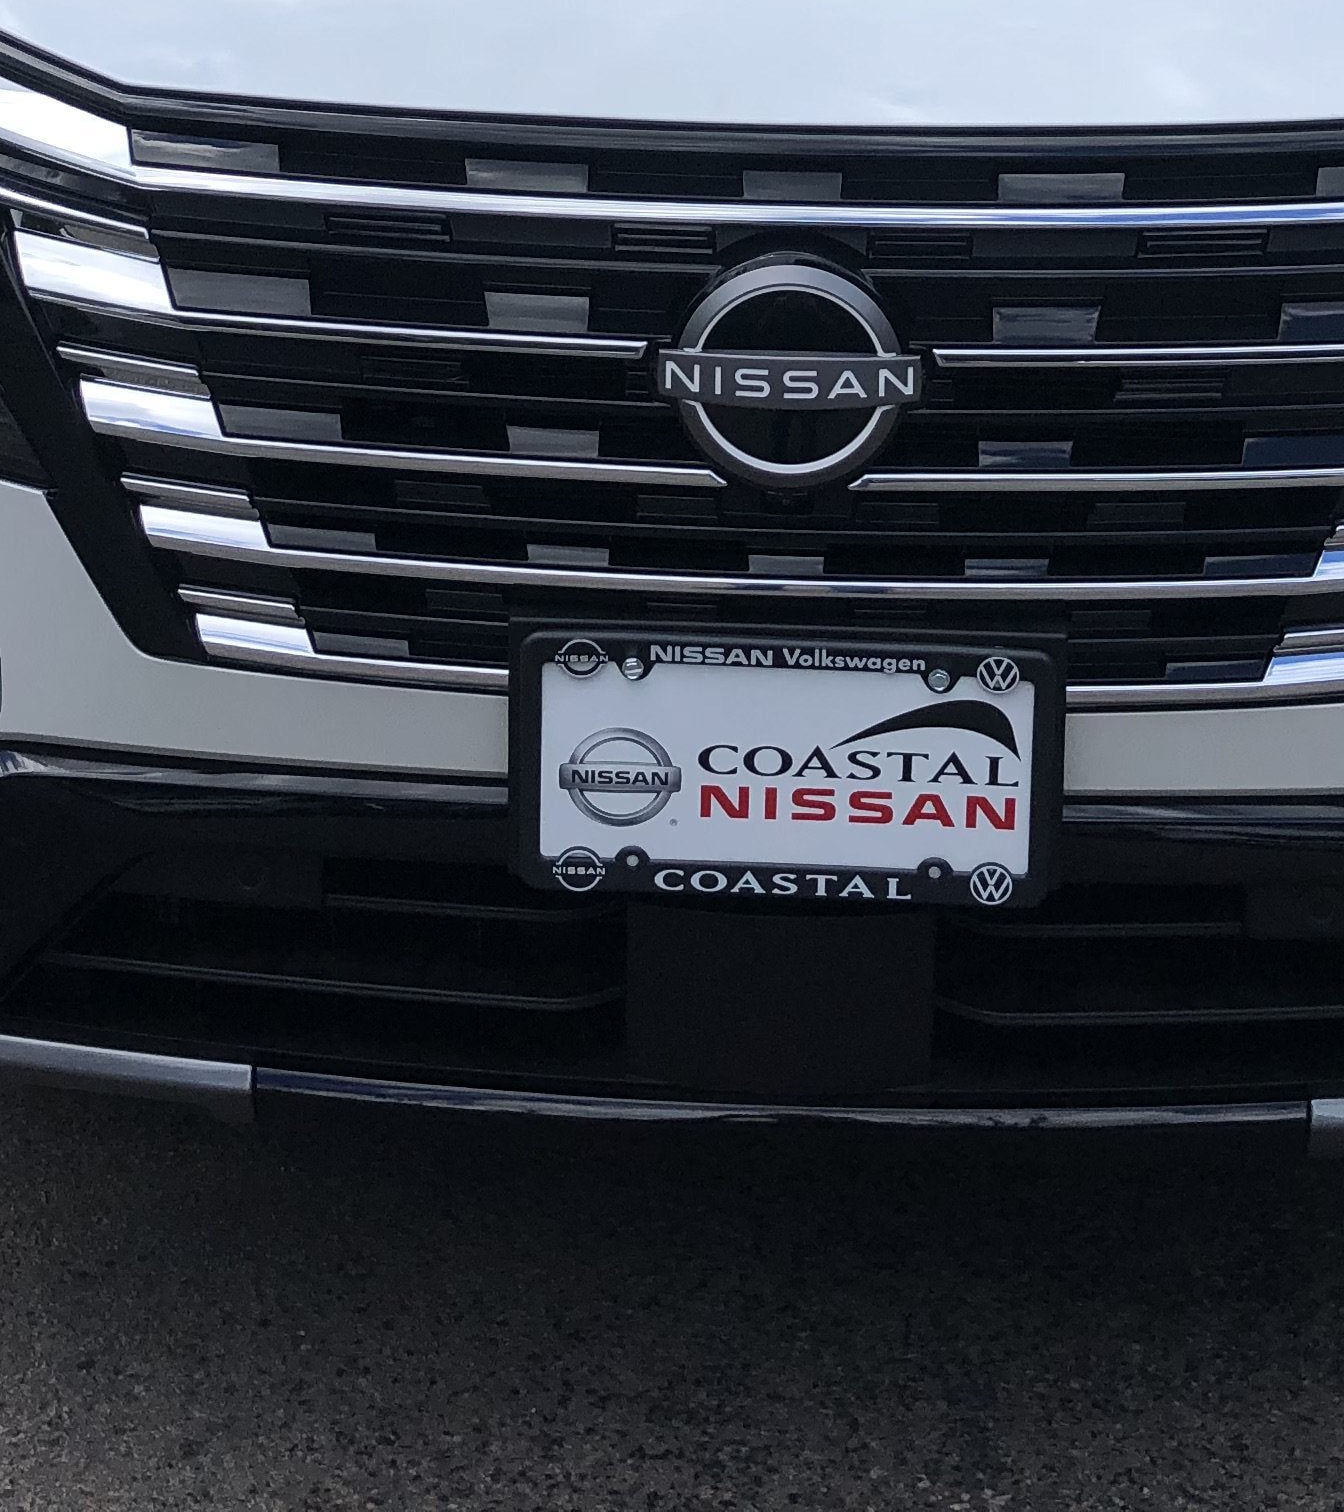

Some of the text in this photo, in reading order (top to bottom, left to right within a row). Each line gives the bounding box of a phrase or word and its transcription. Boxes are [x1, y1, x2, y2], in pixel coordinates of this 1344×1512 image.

[665, 361, 914, 399] NISSAN
[554, 654, 609, 663] NISSAN
[650, 645, 926, 673] NISSAN Volkswagen
[571, 768, 669, 786] NISSAN
[697, 744, 1020, 788] COASTAL
[699, 785, 1017, 831] NISSAN
[552, 866, 606, 875] NISSAN
[654, 869, 912, 900] COASTAL
